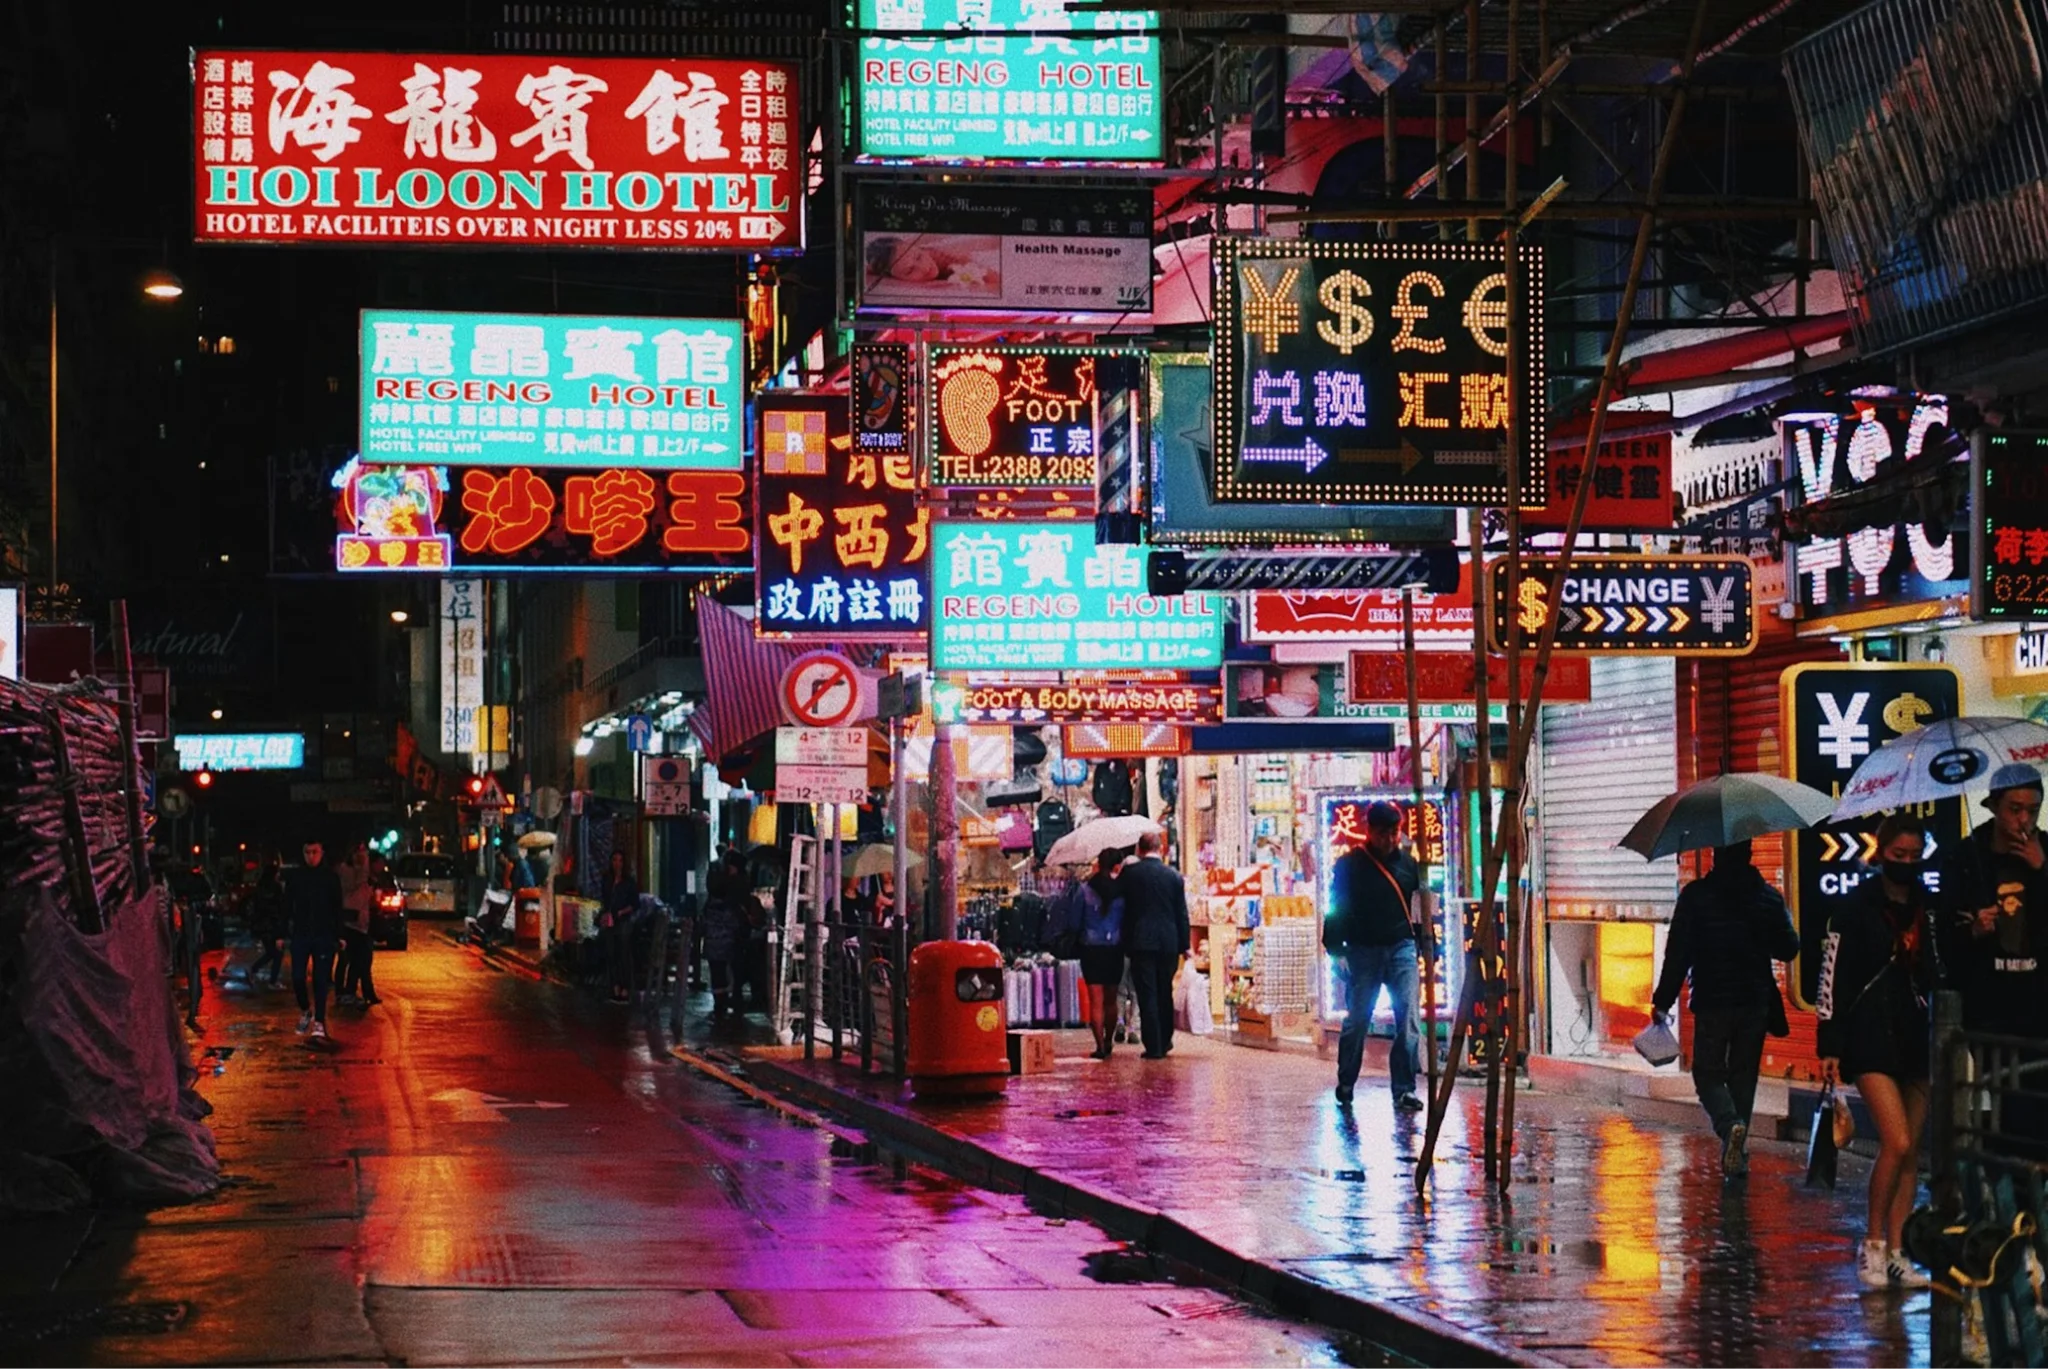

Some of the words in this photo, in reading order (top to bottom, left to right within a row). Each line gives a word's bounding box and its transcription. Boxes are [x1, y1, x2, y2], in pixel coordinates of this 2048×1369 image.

[865, 60, 1008, 86] REGENG
[1040, 63, 1151, 88] HOTEL
[267, 60, 731, 171] 海龍賓館
[866, 118, 901, 131] HOTEL
[866, 133, 901, 145] HOTEL
[205, 165, 340, 207] HOI
[354, 168, 547, 210] LOON
[561, 170, 790, 213] HOTEL
[950, 196, 1021, 219] Massage
[205, 213, 297, 234] HOTEL
[303, 214, 451, 237] FACILITEIS
[456, 217, 528, 238] OVER
[534, 217, 619, 239] NIGHT
[625, 219, 689, 240] LESS
[694, 221, 733, 240] 20%
[1015, 243, 1058, 254] Health
[1063, 245, 1121, 258] Massage
[1316, 270, 1375, 355] $
[1391, 271, 1447, 354] £
[371, 321, 734, 384] 麗晶賓館
[375, 379, 553, 403] REGENG
[589, 384, 728, 409] HOTEL
[1007, 400, 1083, 422] FOOT
[369, 428, 413, 439] HOTEL
[418, 429, 476, 441] FACILITY
[369, 440, 414, 452] HOTEL
[767, 576, 924, 625] 政府註冊
[944, 595, 1080, 617] REGENG
[1107, 596, 1213, 615] HOTEL
[1517, 576, 1548, 634] $
[1561, 578, 1690, 603] CHANGE
[1699, 576, 1735, 634] ¥
[1368, 608, 1433, 622] BEATY
[962, 691, 1015, 709] FOOT
[1021, 690, 1033, 709] &
[1038, 687, 1095, 710] BODY
[1101, 689, 1198, 710] MASSAGE
[1334, 705, 1389, 717] HOTEL
[1400, 706, 1441, 717] FEE
[1816, 692, 1870, 769] ¥
[1820, 871, 1941, 895] CHE
